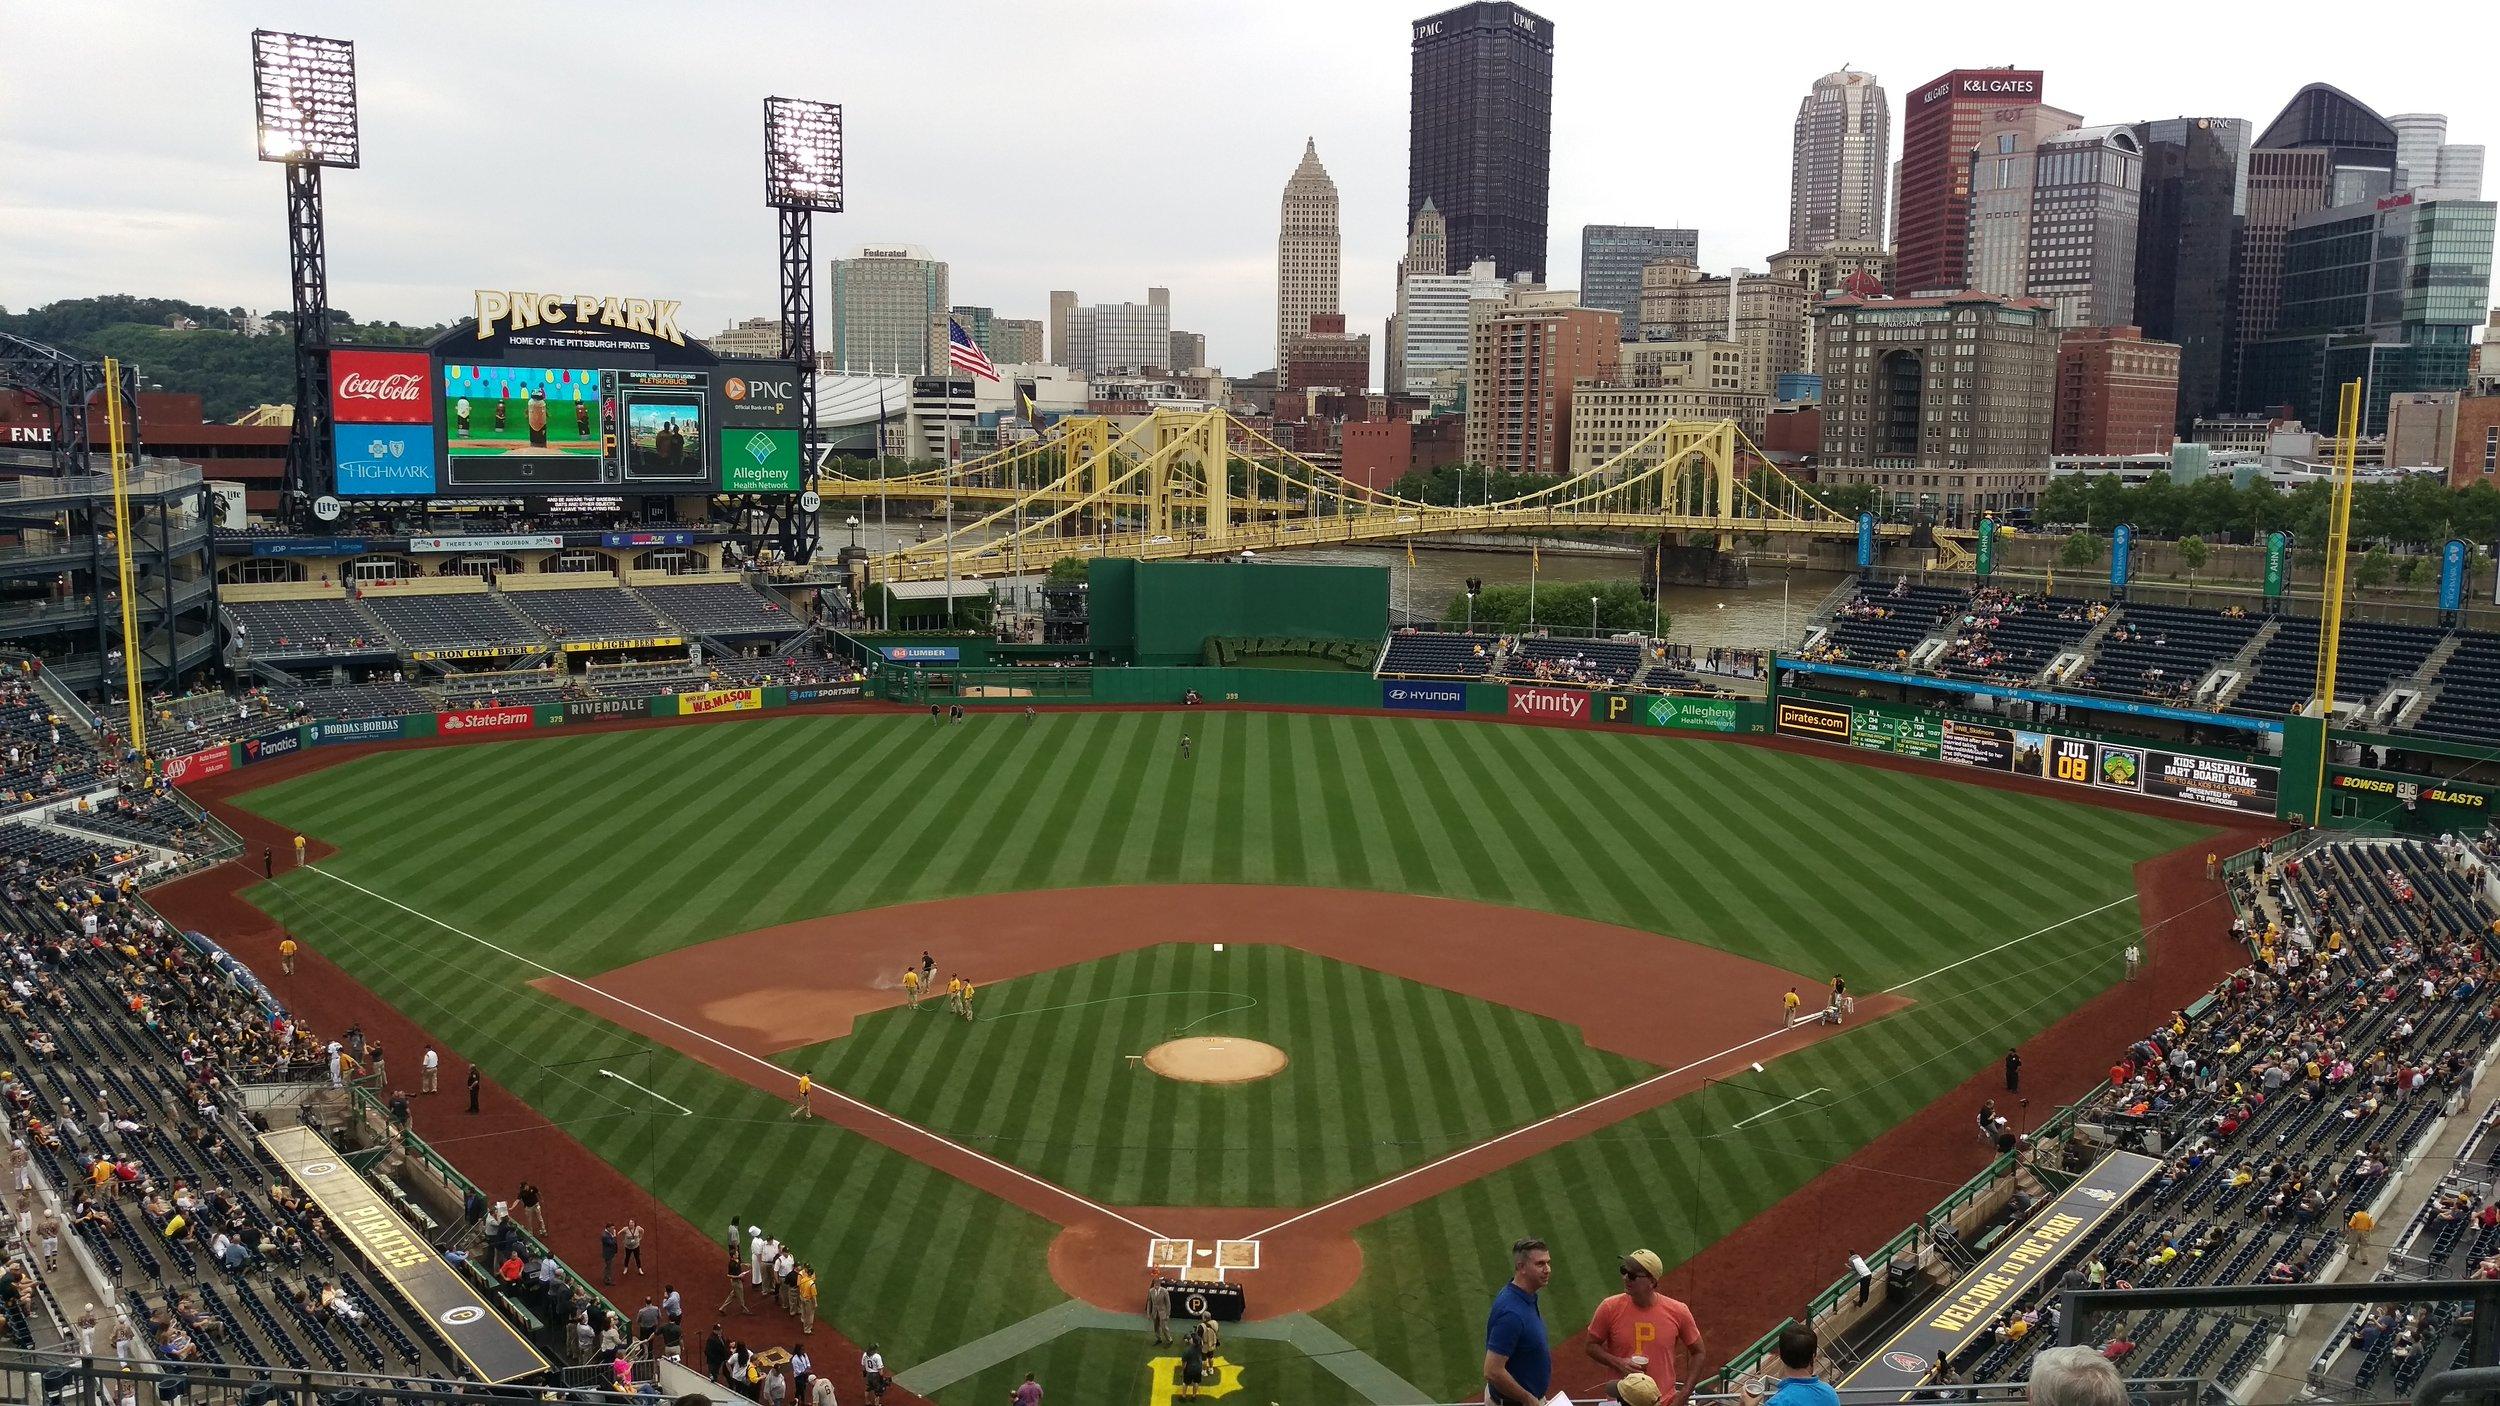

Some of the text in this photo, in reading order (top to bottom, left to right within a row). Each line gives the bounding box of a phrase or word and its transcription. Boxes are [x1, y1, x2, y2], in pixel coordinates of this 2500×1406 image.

[1412, 21, 1442, 40] UPMC
[1513, 12, 1536, 33] UPMC
[1933, 83, 1950, 100] GATES
[1964, 80, 2033, 92] K&L GATES
[2210, 118, 2232, 129] PNC
[864, 248, 906, 258] Federated
[475, 290, 686, 347] PNC PARK
[1879, 320, 1924, 328] RENAISSANCE
[510, 336, 650, 350] HOME OF THE PITTSBURGH PIRATES
[340, 372, 424, 400] Coca-Cola
[748, 380, 792, 399] PNC
[346, 463, 430, 479] HIGHMARK
[733, 468, 788, 480] Allegheny
[227, 490, 241, 500] Lite
[803, 496, 818, 506] Lite
[317, 502, 338, 514] Lite
[652, 507, 664, 515] Lite
[271, 545, 286, 553] JDP
[1980, 536, 1988, 553] AHN
[2270, 552, 2279, 572] AHN
[589, 638, 655, 650] IC LIGHT BEER
[434, 646, 527, 659] IRON CITY BEER
[892, 649, 906, 657] 84
[800, 687, 860, 699] AT&T SPORTSNET
[1225, 692, 1239, 700] 399
[1410, 691, 1460, 701] HYUNDAI
[571, 699, 644, 715] RIVENDALE
[1514, 690, 1584, 717] xfinity
[1610, 696, 1627, 720] P
[1682, 705, 1736, 720] Allegheny
[1785, 710, 1843, 729] pirates.com
[324, 720, 398, 736] BORDAS BORDAS
[1681, 717, 1734, 727] Health Network
[1924, 709, 2102, 740] WELCOME TO PNC PARK
[260, 737, 297, 756] Fanatics
[2058, 741, 2089, 759] JUL
[168, 750, 228, 777] AAA Auto Insurance
[205, 764, 223, 773] AAA.com
[2058, 756, 2087, 781] 08
[2173, 756, 2249, 777] KIDS BASEBALL
[2164, 765, 2257, 788] DART BOARD GAME
[2164, 775, 2178, 783] FREE
[2227, 786, 2256, 796] YOUNGER
[2186, 787, 2222, 798] PRESENTED
[2342, 777, 2484, 806] BOWSER 33 BLASTS
[2179, 792, 2238, 806] MRS. T'S PIEROGIES
[343, 1205, 430, 1268] PIRATES
[1930, 1212, 2084, 1332] WELCOME TO PNC PARK
[1192, 1299, 1200, 1310] P
[1634, 1322, 1656, 1354] P
[824, 1385, 830, 1395] 6
